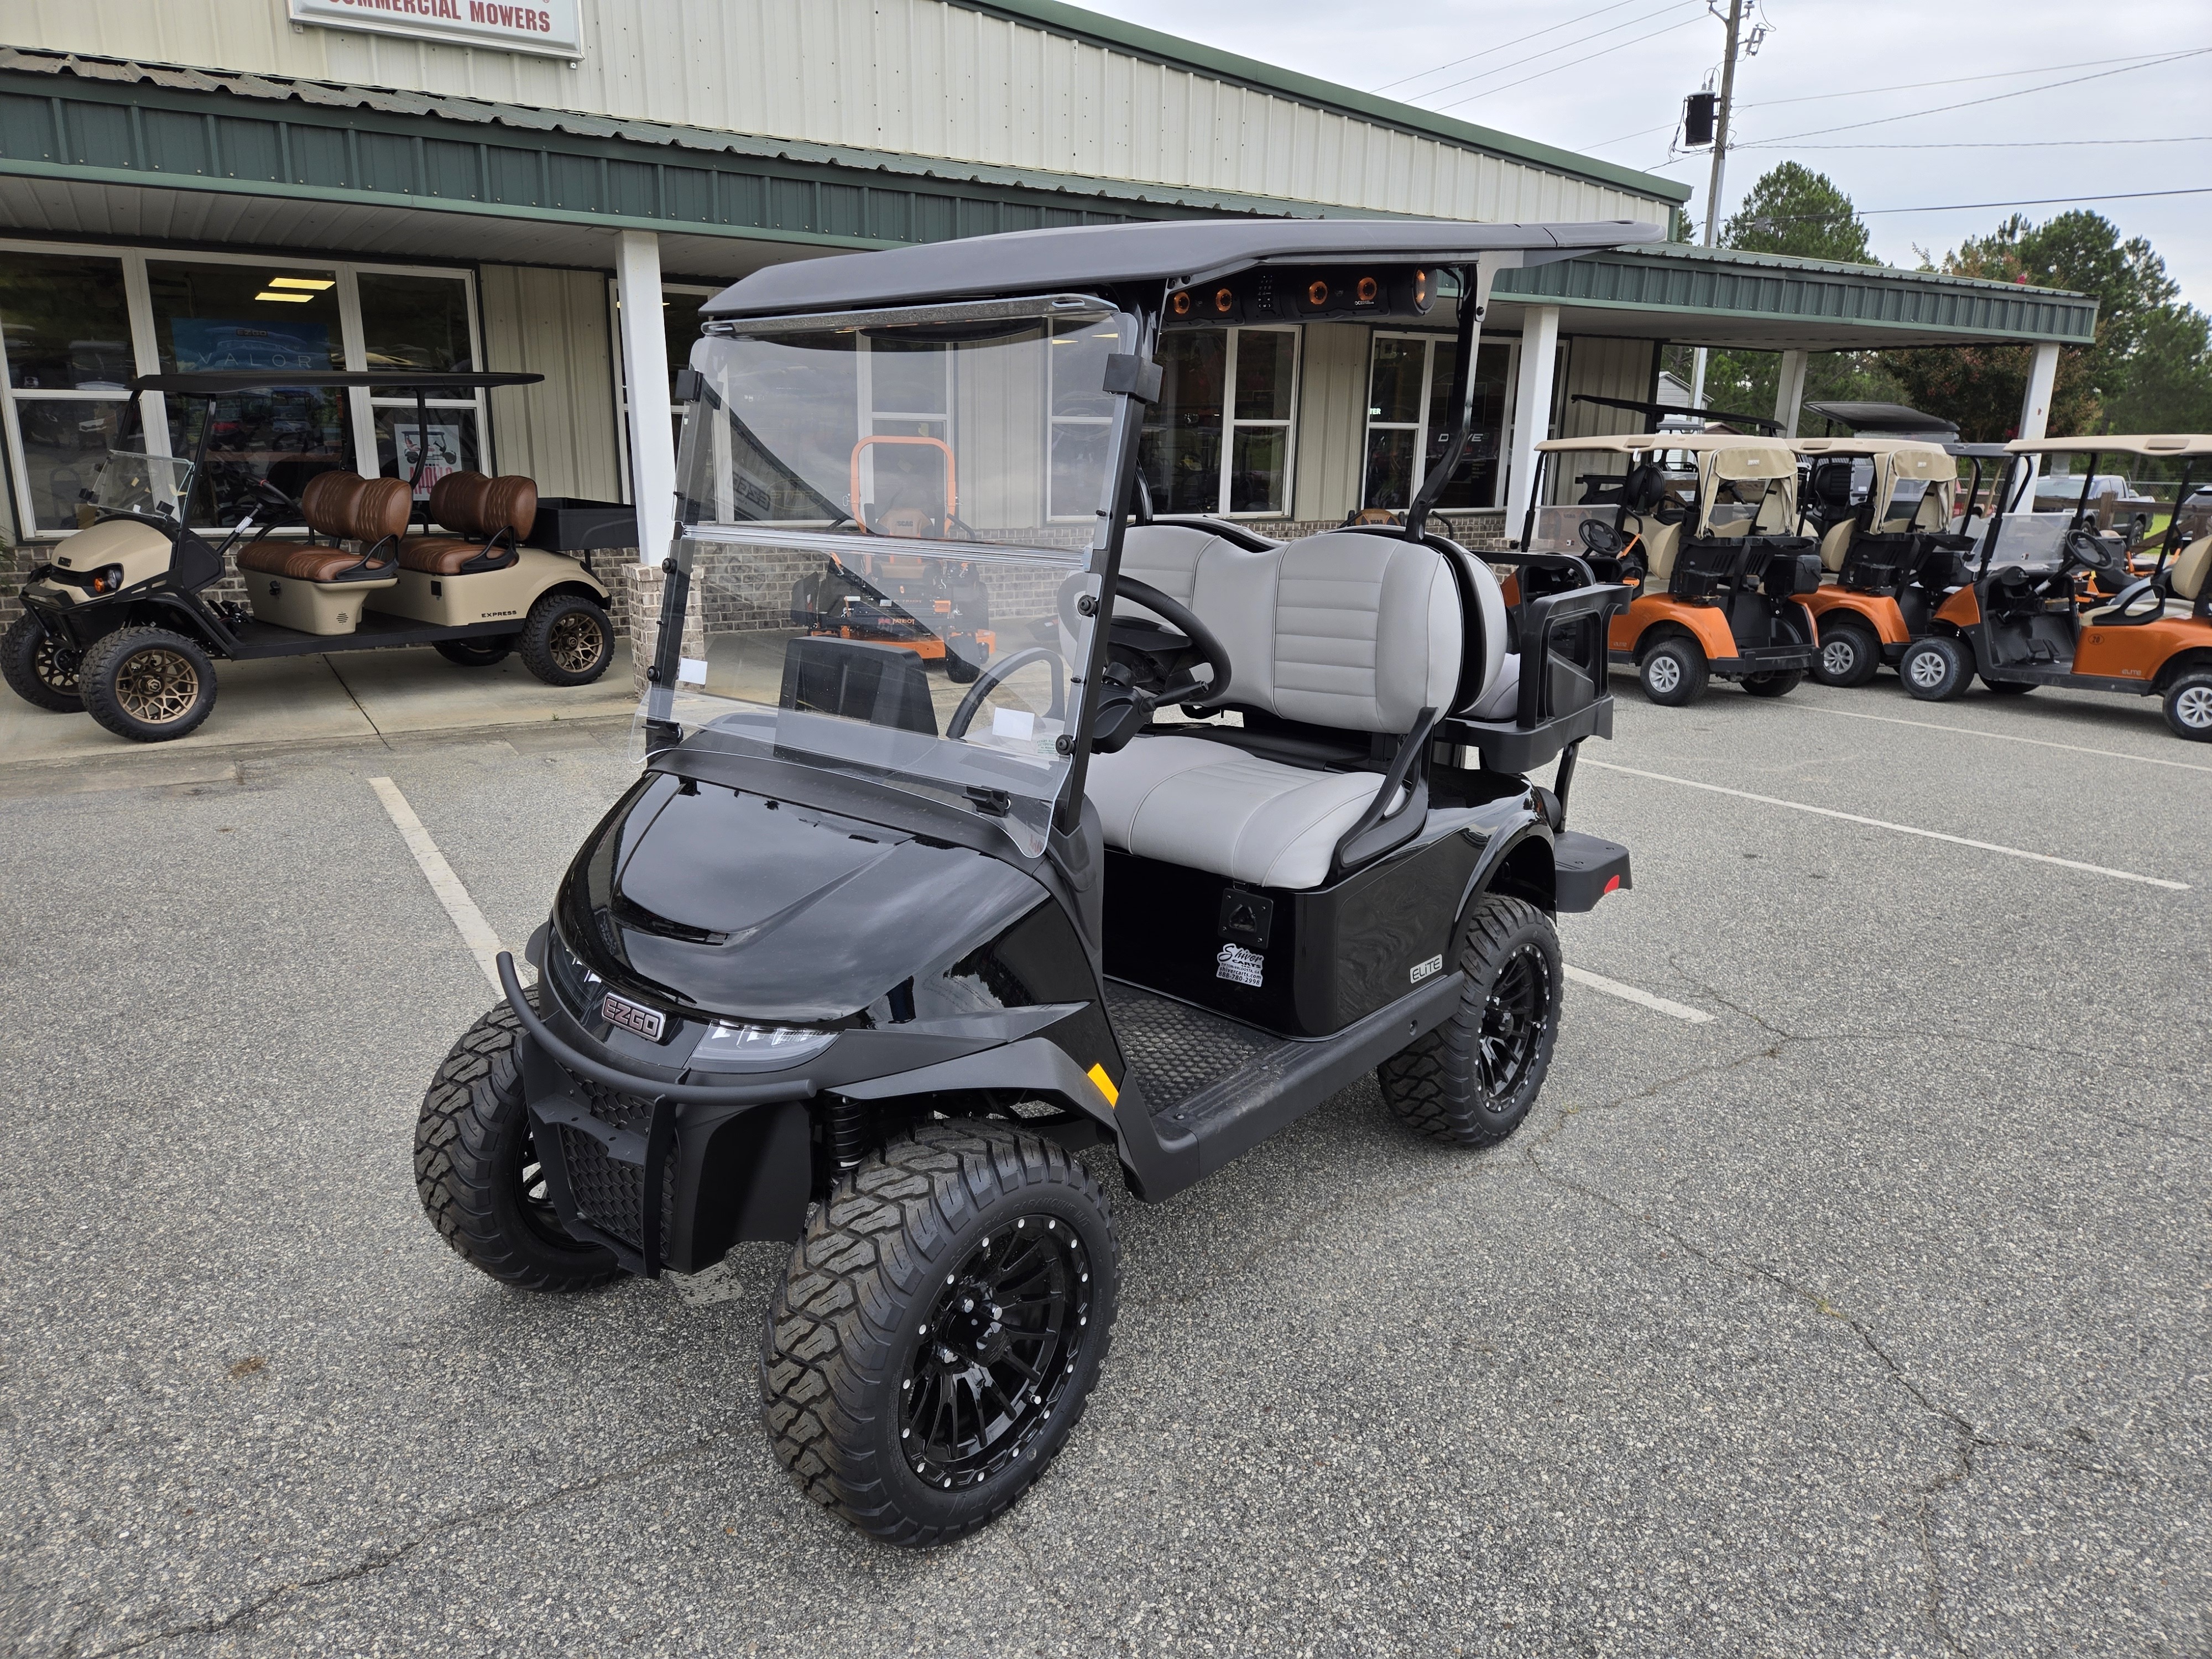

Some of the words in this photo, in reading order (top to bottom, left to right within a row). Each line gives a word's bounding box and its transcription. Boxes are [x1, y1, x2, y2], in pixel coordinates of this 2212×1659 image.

[328, 0, 461, 20] ERCIAL
[469, 0, 550, 32] MOWERS
[198, 352, 312, 368] VALOR
[1218, 945, 1262, 962] Shiver
[1232, 959, 1261, 969] CARTS
[1218, 971, 1260, 985] 888-780-2998
[1219, 966, 1261, 980] shivercarts.com
[603, 998, 659, 1036] EZGO
